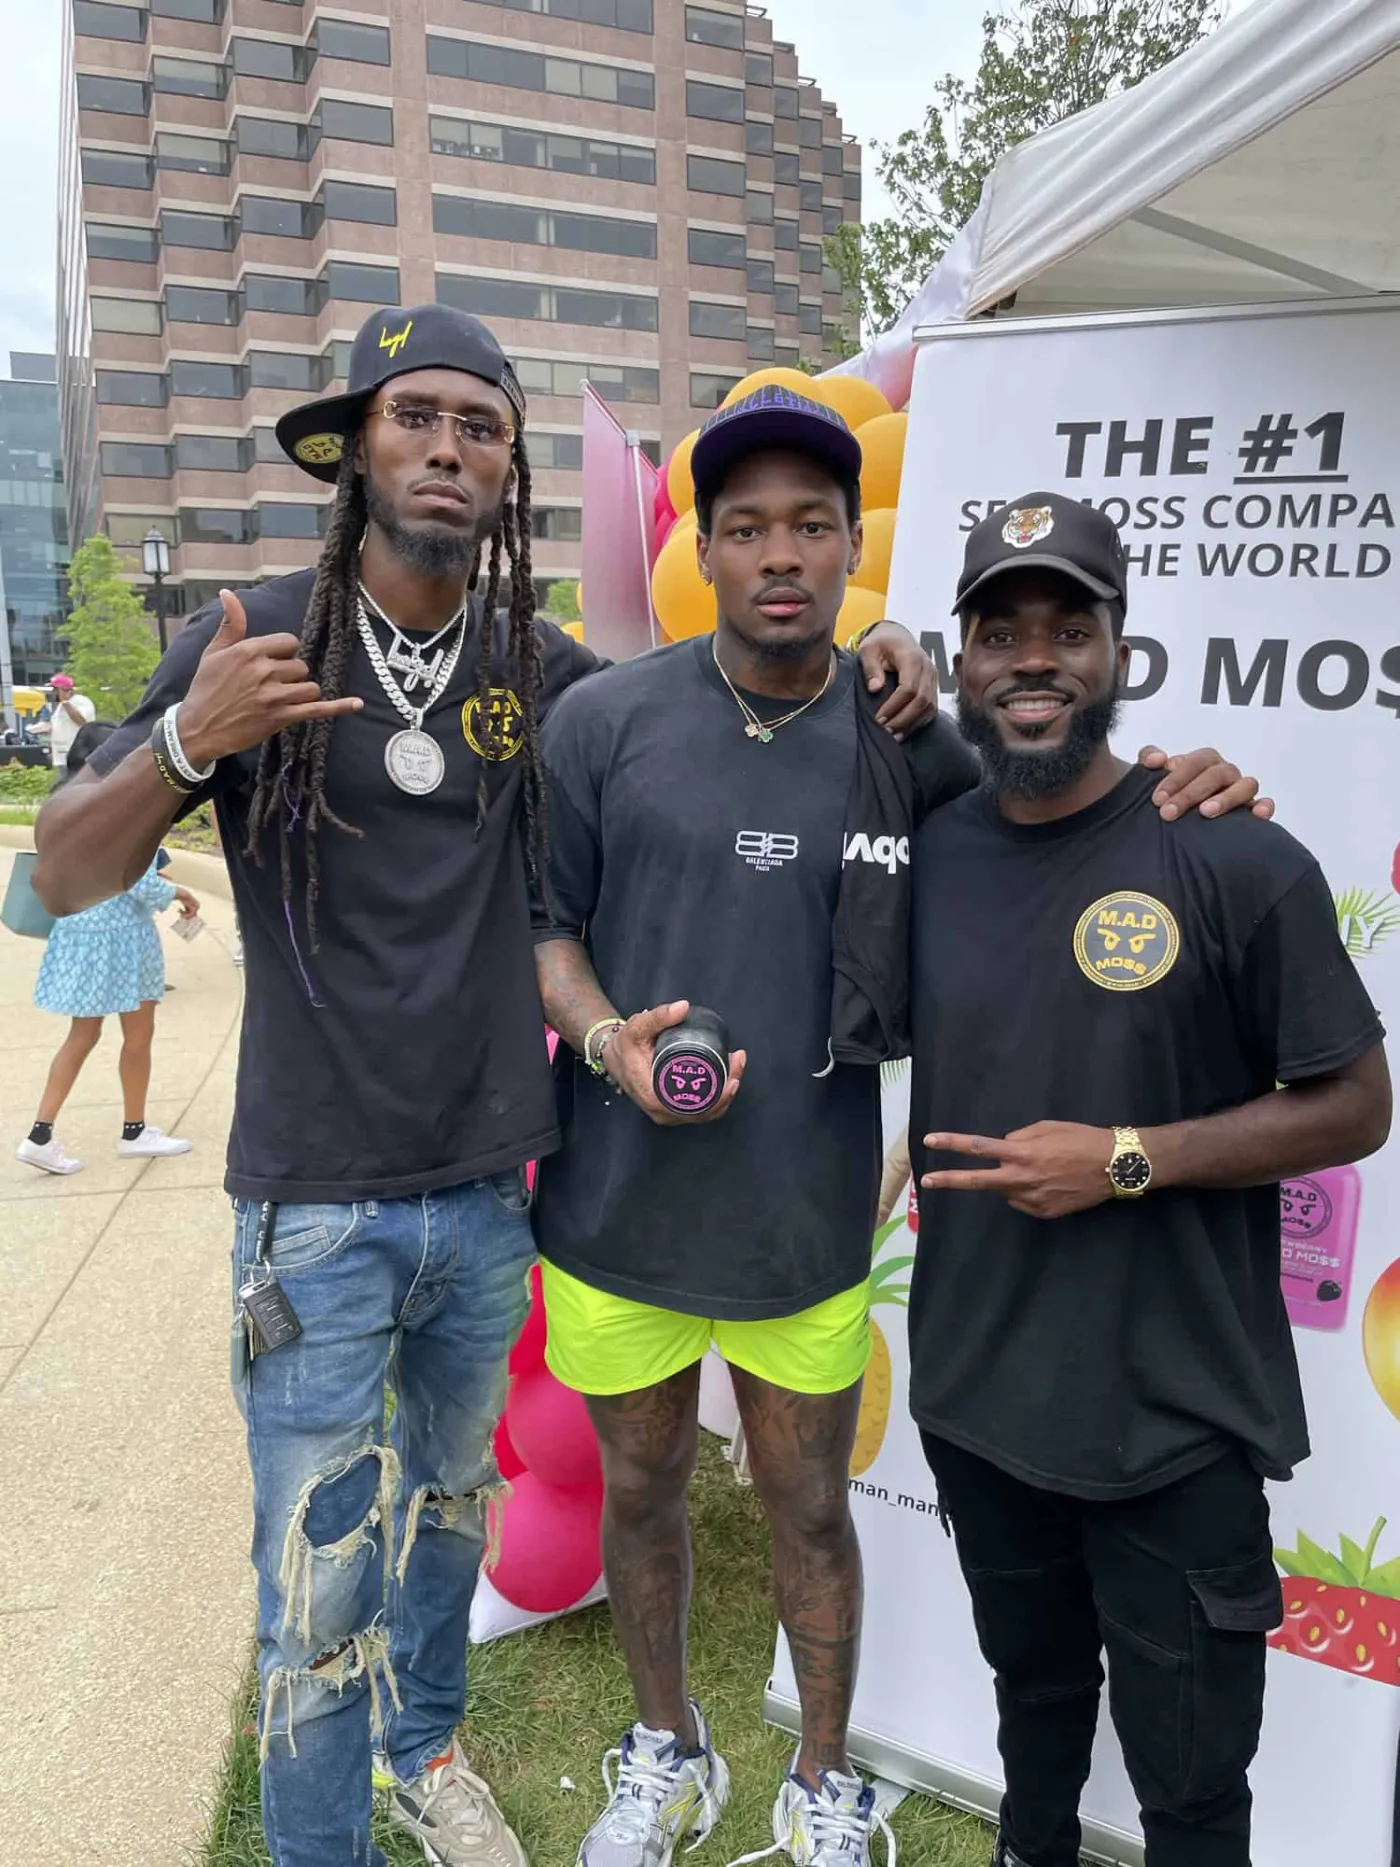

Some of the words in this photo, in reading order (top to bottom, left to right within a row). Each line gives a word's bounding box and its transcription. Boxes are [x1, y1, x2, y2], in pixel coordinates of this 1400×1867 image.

[1055, 416, 1214, 478] THE
[1238, 412, 1345, 473] #1
[1081, 496, 1187, 530] OSS
[1122, 543, 1181, 576] HE
[1197, 543, 1391, 578] WORLD
[1098, 910, 1157, 929] M.A.D
[673, 1065, 706, 1075] M.A.D
